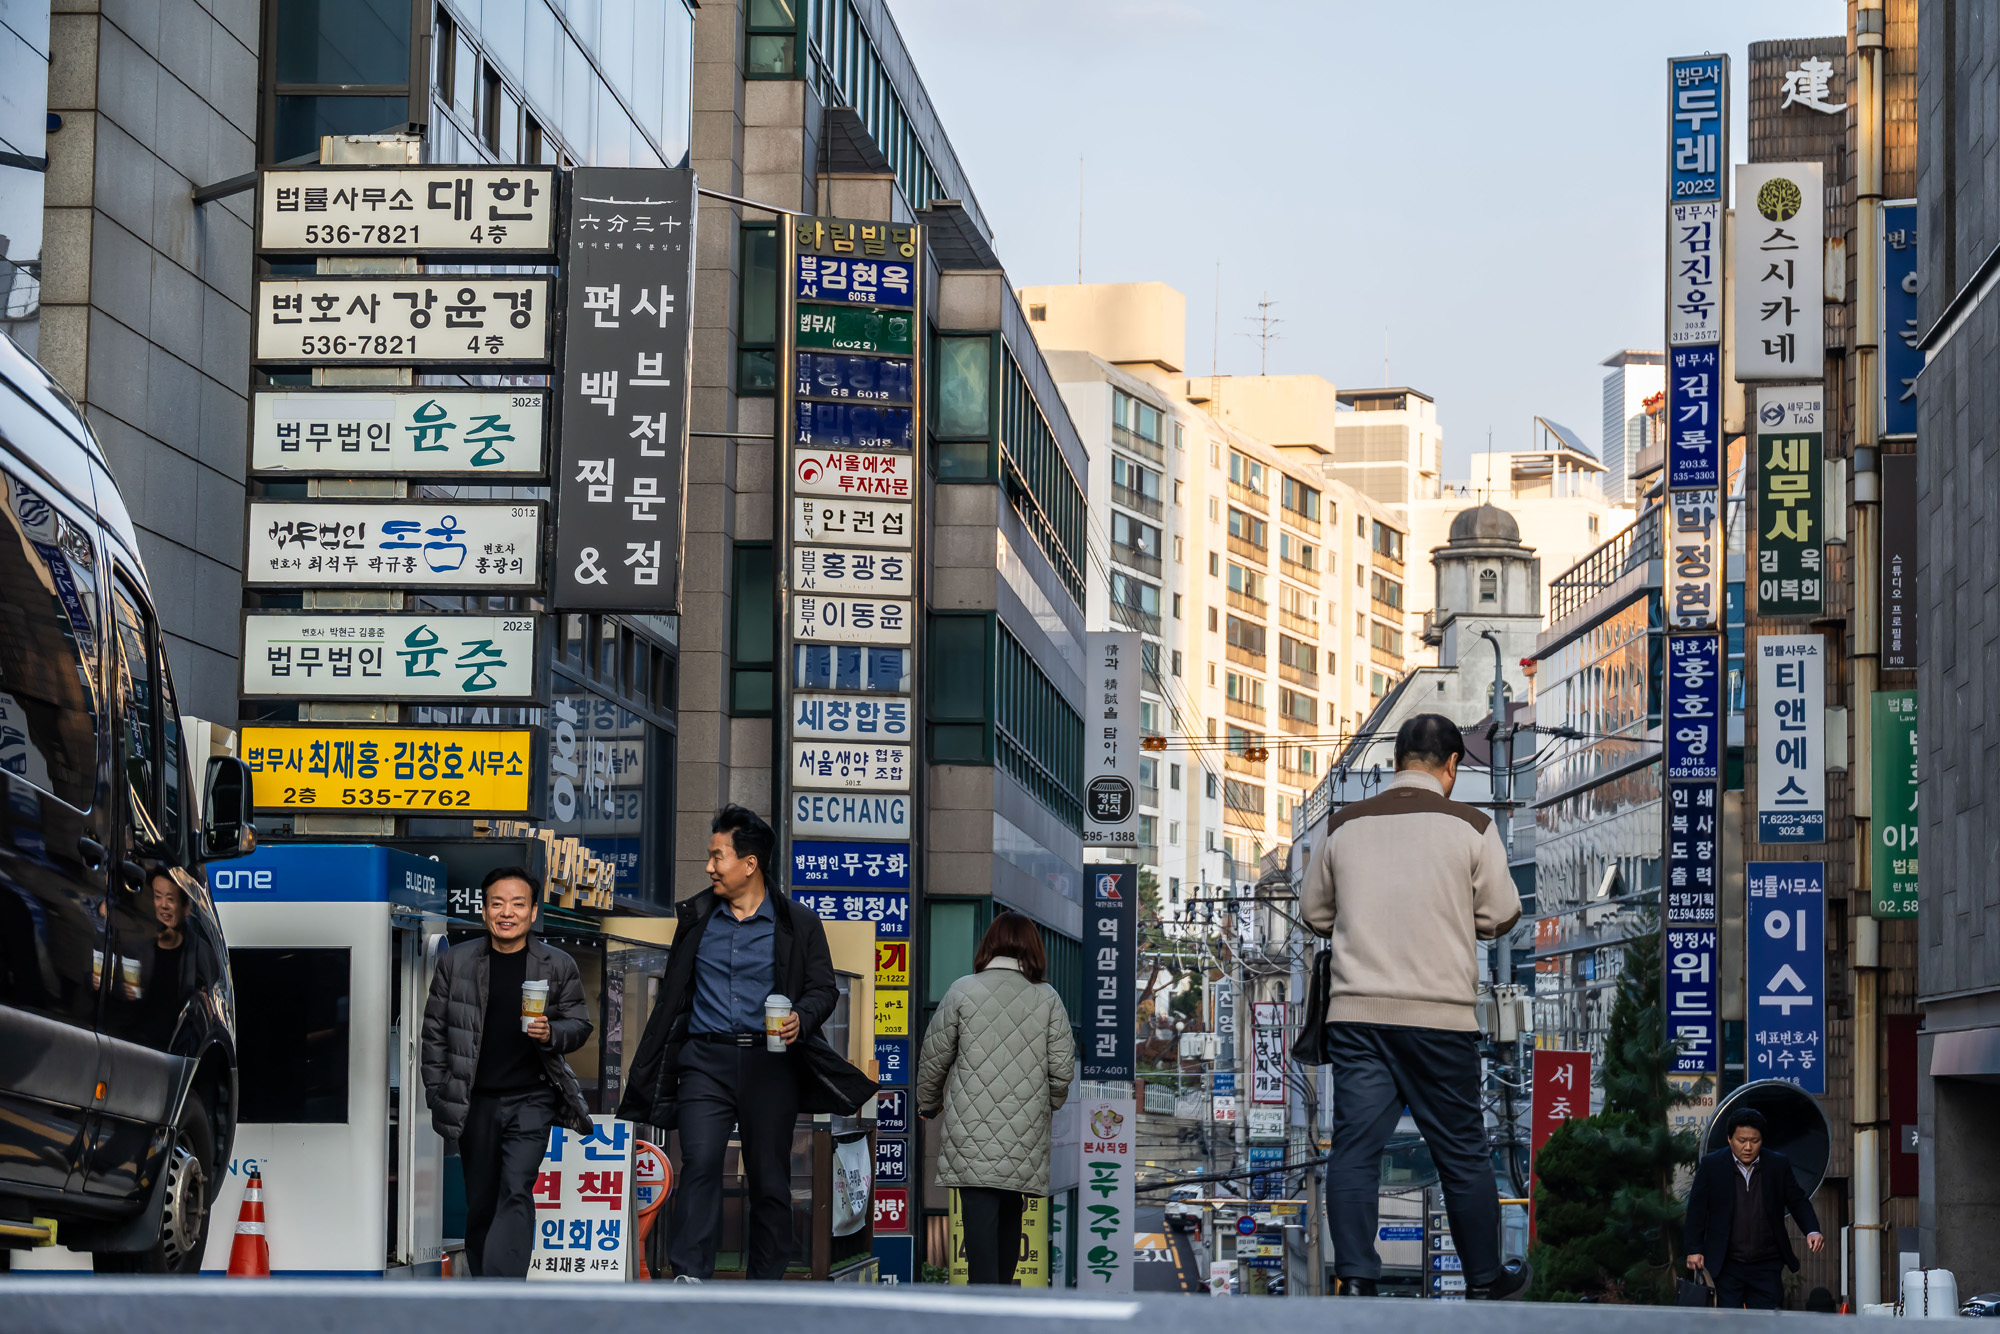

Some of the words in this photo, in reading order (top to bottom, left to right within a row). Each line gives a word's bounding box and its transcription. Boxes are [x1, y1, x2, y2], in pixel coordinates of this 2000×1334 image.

[1675, 65, 1720, 87] 법무사
[1781, 56, 1847, 115] 建
[1675, 90, 1718, 174] 두레
[1676, 179, 1716, 195] 202호
[277, 187, 414, 212] 법률사무소
[427, 178, 540, 221] 대한
[1674, 203, 1718, 221] 법무사
[579, 213, 681, 234] 六分三十
[305, 224, 421, 245] 536-7821
[470, 224, 508, 244] 4층
[797, 221, 916, 258] 하림빌딩
[801, 256, 817, 298] 법무사
[820, 260, 909, 294] 김현옥
[1677, 221, 1715, 320] 김진욱
[848, 292, 876, 302] 605호
[1760, 228, 1800, 364] 스시카네
[273, 292, 381, 325] 변호사
[393, 288, 533, 330] 강윤경
[800, 314, 836, 334] 법무사
[1685, 321, 1706, 330] 303호
[302, 335, 417, 355] 536-7821
[467, 335, 505, 354] 4층
[1673, 330, 1718, 342] 313-2577
[1675, 353, 1715, 367] 법무사
[511, 397, 542, 409] 302호
[857, 390, 889, 399] 601호
[1676, 373, 1712, 453] 김기록
[1787, 401, 1821, 412] 세무그룹
[277, 422, 391, 454] 법무법인
[405, 399, 516, 468] 윤중
[623, 285, 675, 586] 샤브전문점
[826, 454, 896, 474] 서울에셋
[1680, 459, 1708, 469] 203호
[838, 476, 909, 495] 투자자문
[1673, 471, 1715, 481] 535-3303
[1674, 491, 1718, 506] 변호사
[1765, 439, 1812, 542] 세무사
[511, 507, 536, 518] 301호
[803, 502, 814, 539] 법무사
[822, 508, 903, 535] 안권섭
[268, 521, 366, 551] 법무법인
[379, 515, 467, 573] 도움
[483, 543, 516, 555] 변호사
[270, 558, 302, 570] 변호사
[308, 556, 359, 573] 최석두
[368, 556, 418, 573] 곽규홍
[475, 557, 523, 574] 홍광의
[574, 546, 608, 585] &
[801, 551, 816, 590] 법무사
[822, 553, 904, 581] 홍광호
[1675, 506, 1715, 617] 박정현
[1892, 554, 1902, 598] 스튜디오
[1760, 579, 1820, 602] 이복희
[502, 620, 533, 633] 202호
[801, 598, 816, 637] 법무사
[822, 602, 903, 630] 이동윤
[301, 627, 325, 638] 변호사
[329, 626, 356, 638] 박현근
[1892, 605, 1902, 651] 프로필름
[268, 646, 383, 677] 법무법인
[396, 623, 508, 692] 윤중
[1671, 639, 1718, 656] 변호사
[1763, 645, 1818, 657] 법률사무소
[1673, 658, 1715, 755] 홍호영
[1888, 698, 1917, 712] 법률
[797, 700, 906, 734] 세창합동
[1774, 660, 1808, 805] 티앤에스
[1103, 726, 1118, 769] 담아서
[248, 746, 303, 773] 법무사
[468, 751, 523, 777] 사무소
[800, 750, 869, 777] 서울생약
[875, 748, 904, 763] 협동
[1681, 757, 1705, 766] 301호
[874, 766, 903, 781] 조합
[1669, 767, 1716, 777] 508-0635
[845, 779, 862, 787] 501호
[283, 787, 317, 804] 2층
[341, 787, 471, 807] 535-7762
[797, 796, 905, 824] SECHANG
[1761, 815, 1823, 825] T.6223-3453
[1083, 831, 1135, 842] 595-1388
[1778, 826, 1805, 836] 302호
[795, 854, 839, 871] 법무법인
[841, 853, 908, 878] 무궁화
[805, 872, 829, 881] 205호
[1750, 875, 1822, 898] 법률사무소
[843, 895, 908, 921] 행정사
[1669, 893, 1714, 907] 천일기획
[1668, 908, 1714, 921] 02.594.3555
[881, 923, 903, 933] 301호
[1668, 932, 1715, 949] 행정사
[1759, 909, 1813, 1016] 이수
[1096, 917, 1119, 1058] 역삼검도관
[1755, 1030, 1819, 1047] 대표변호사
[888, 1054, 900, 1070] 윤
[1678, 1060, 1704, 1069] 501호
[1757, 1050, 1816, 1070] 이수동
[1083, 1142, 1128, 1154] 본사직영
[1086, 1161, 1122, 1284] 푸주옥
[532, 1219, 621, 1251] 인회생
[546, 1257, 586, 1273] 최재홍
[590, 1258, 619, 1271] 사무소
